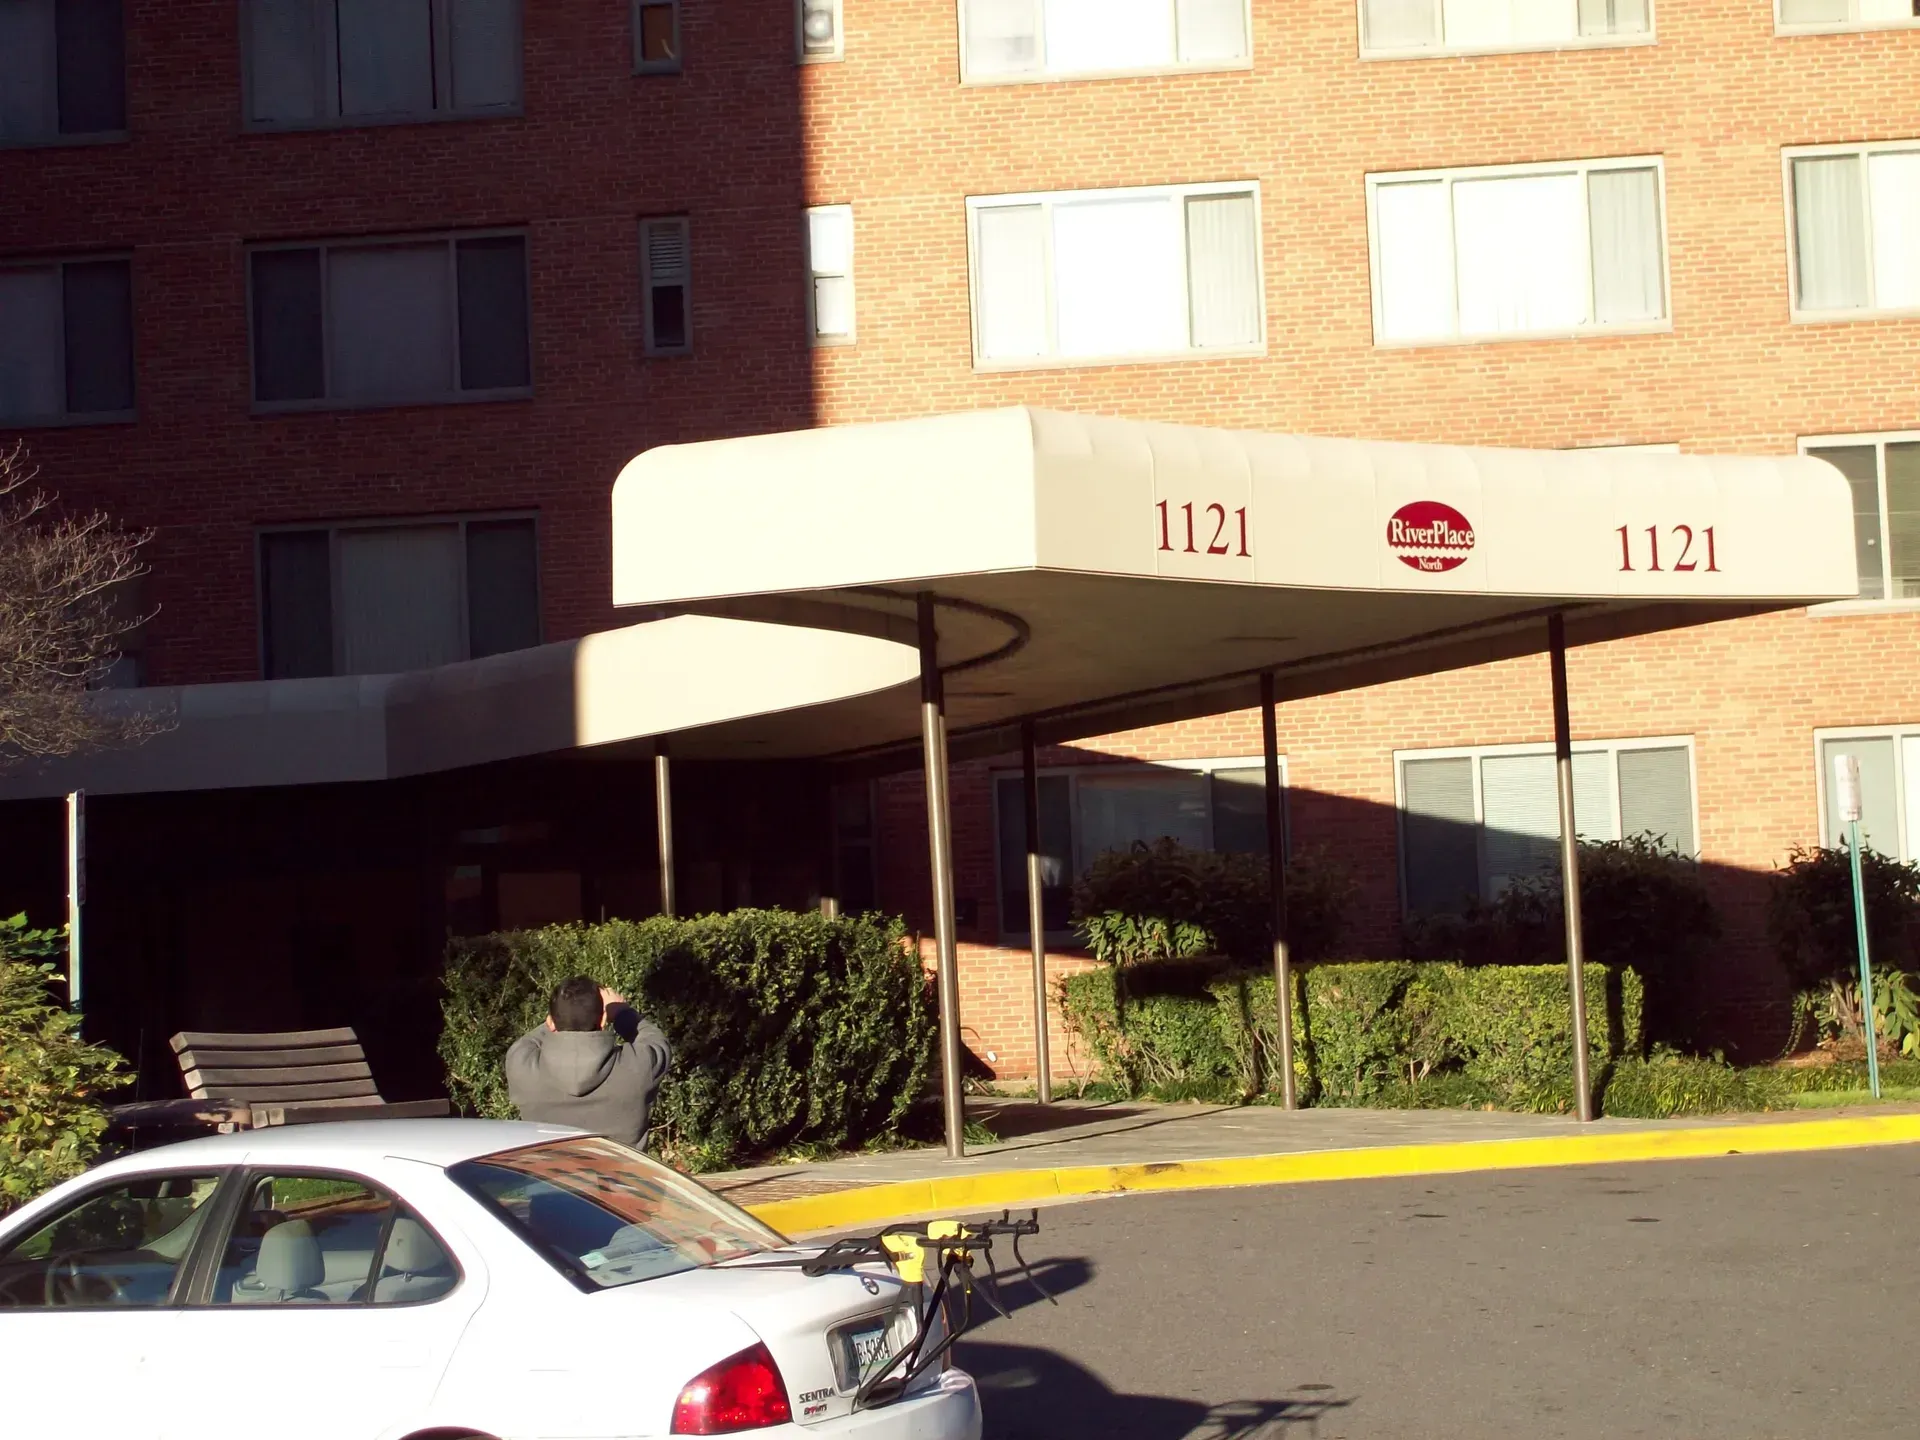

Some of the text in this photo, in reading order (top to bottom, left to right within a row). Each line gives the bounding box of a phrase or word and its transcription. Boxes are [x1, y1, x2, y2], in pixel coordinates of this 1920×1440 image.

[1156, 499, 1252, 557] 1121
[1389, 518, 1474, 545] RiverPlace
[1615, 524, 1722, 572] 1121
[1418, 558, 1443, 570] North
[799, 1387, 835, 1404] SENTRA
